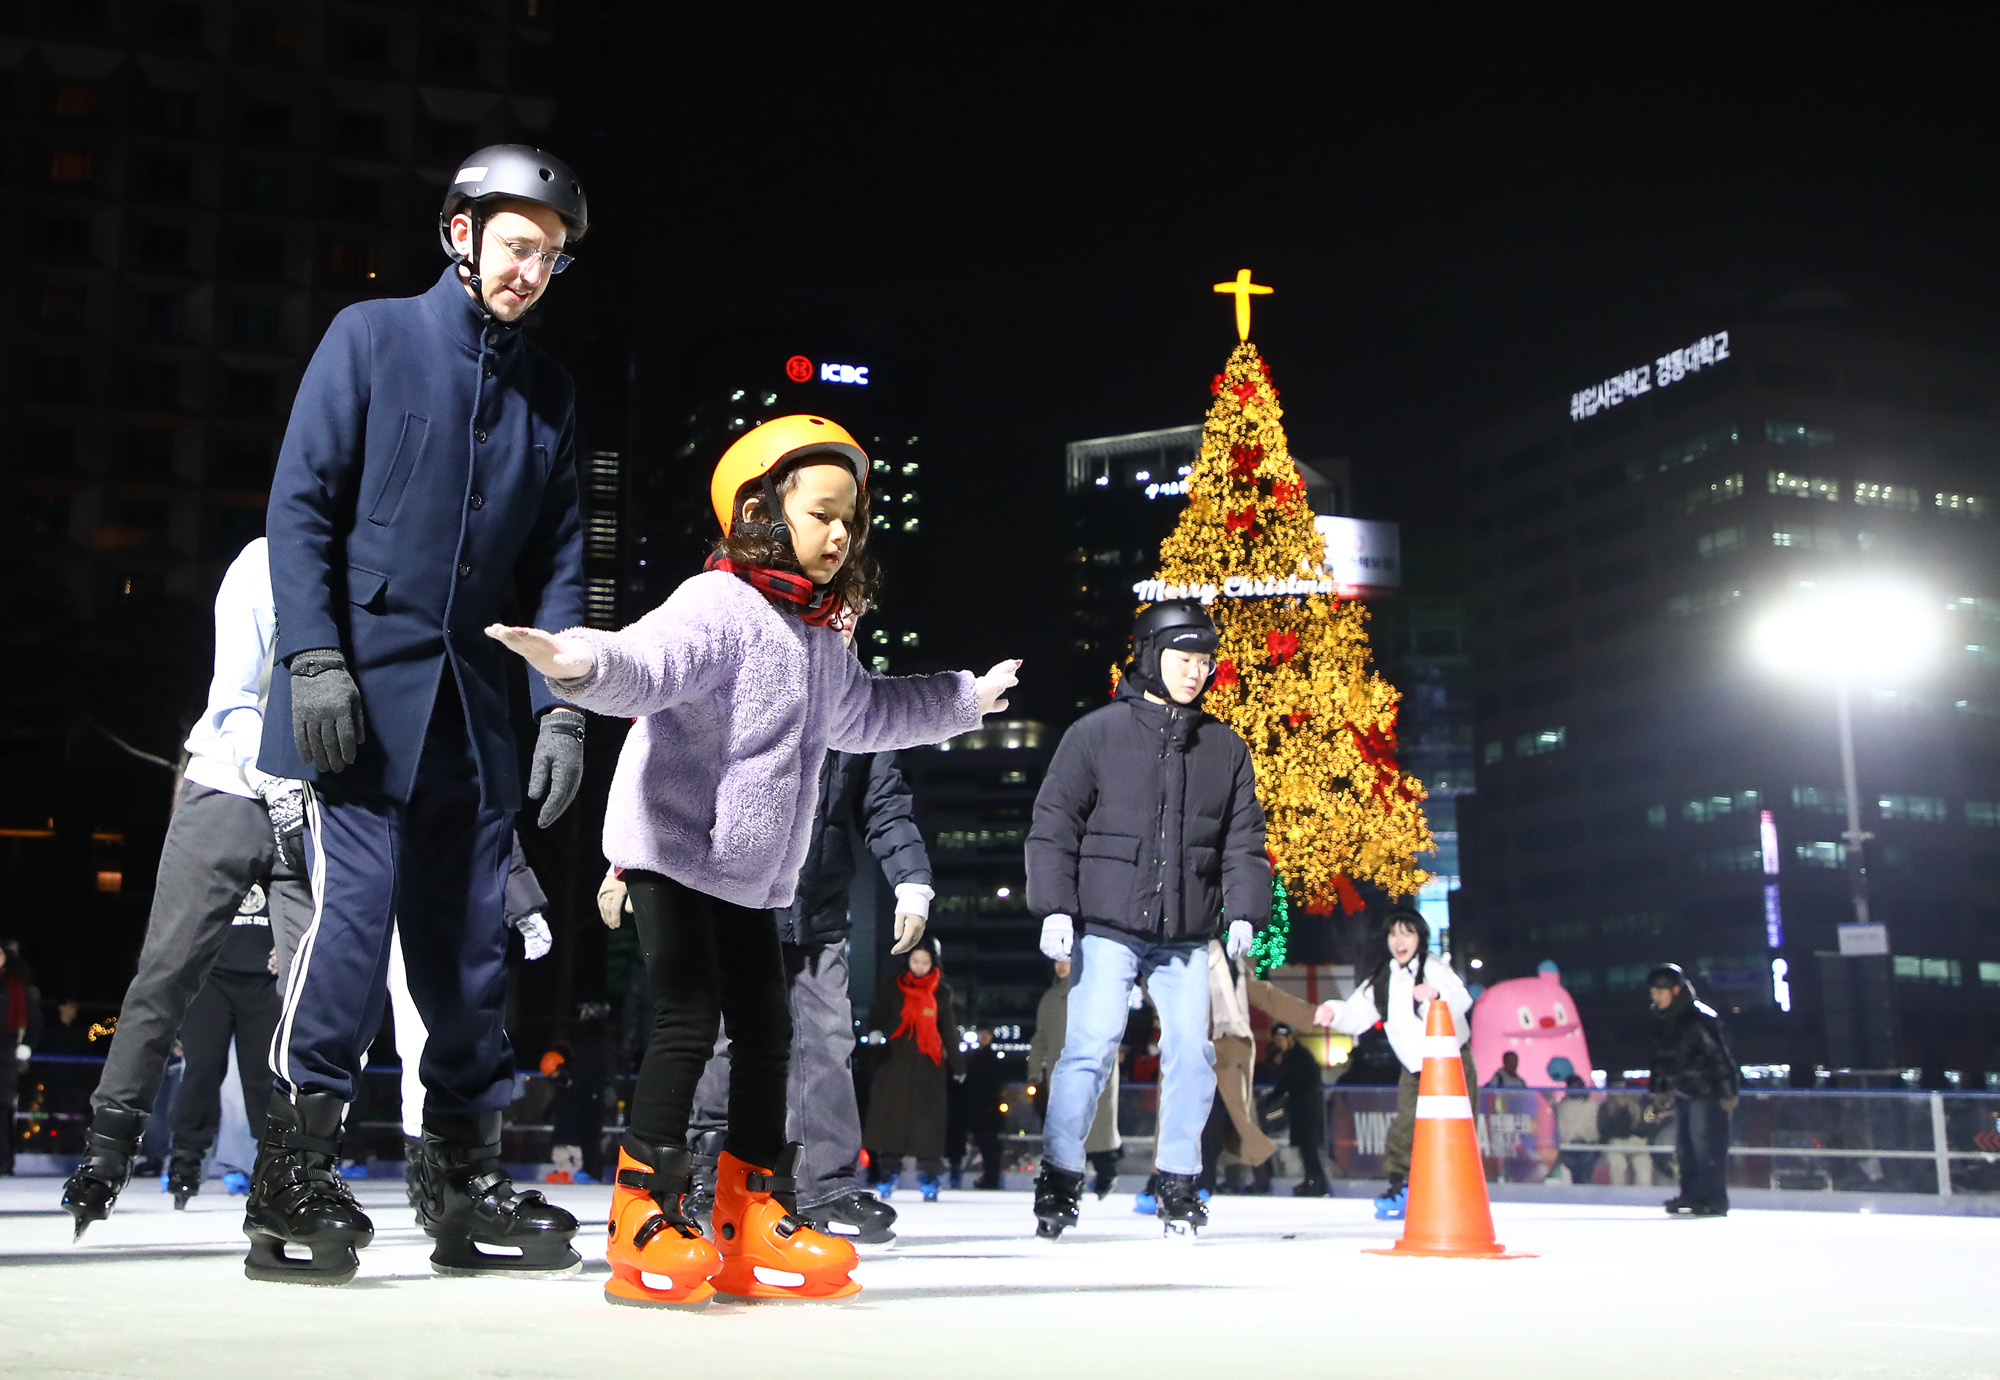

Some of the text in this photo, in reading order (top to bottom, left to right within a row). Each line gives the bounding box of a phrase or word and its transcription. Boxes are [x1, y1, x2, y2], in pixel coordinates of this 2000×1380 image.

[820, 362, 869, 385] ICBC
[1656, 330, 1731, 388] 경동대학교
[1132, 573, 1337, 606] Merry Christma
